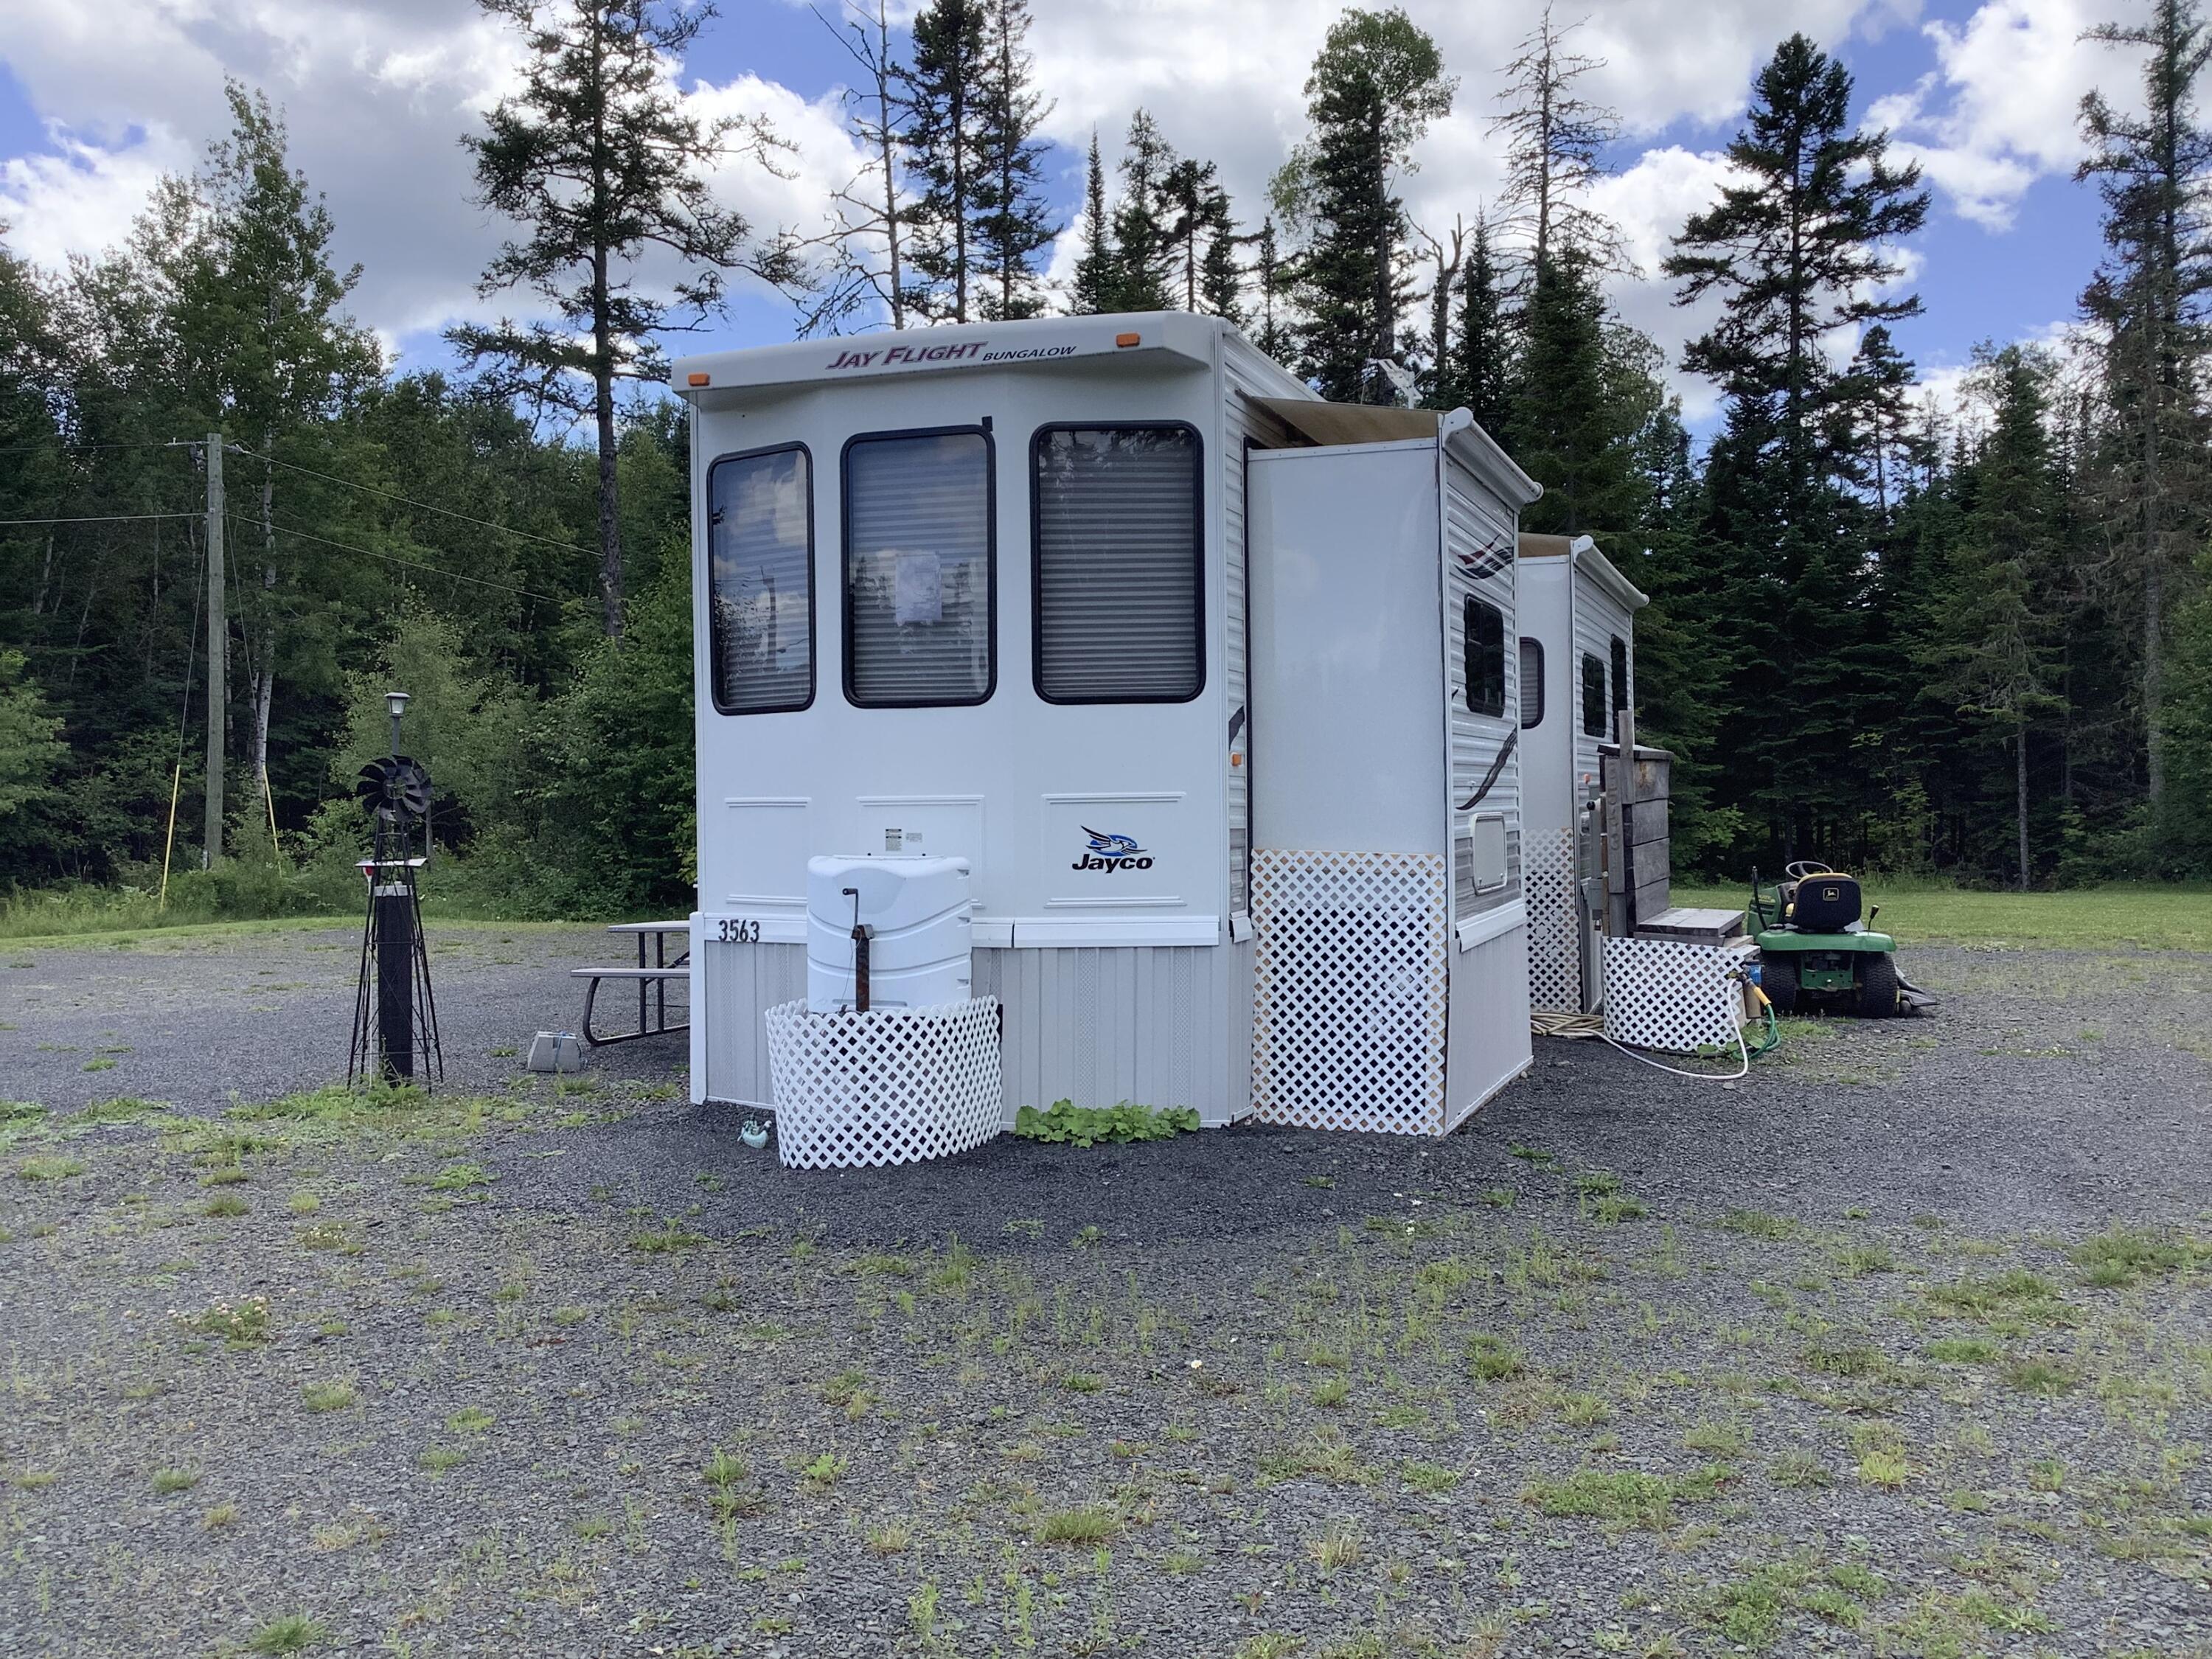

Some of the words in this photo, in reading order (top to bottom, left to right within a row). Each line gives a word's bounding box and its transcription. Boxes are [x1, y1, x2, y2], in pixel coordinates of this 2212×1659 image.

[826, 350, 883, 369] JAY
[881, 341, 989, 366] FLIGHT
[982, 346, 1077, 361] BUNGALOW
[1072, 853, 1153, 874] Jayco
[718, 919, 760, 943] 3563
